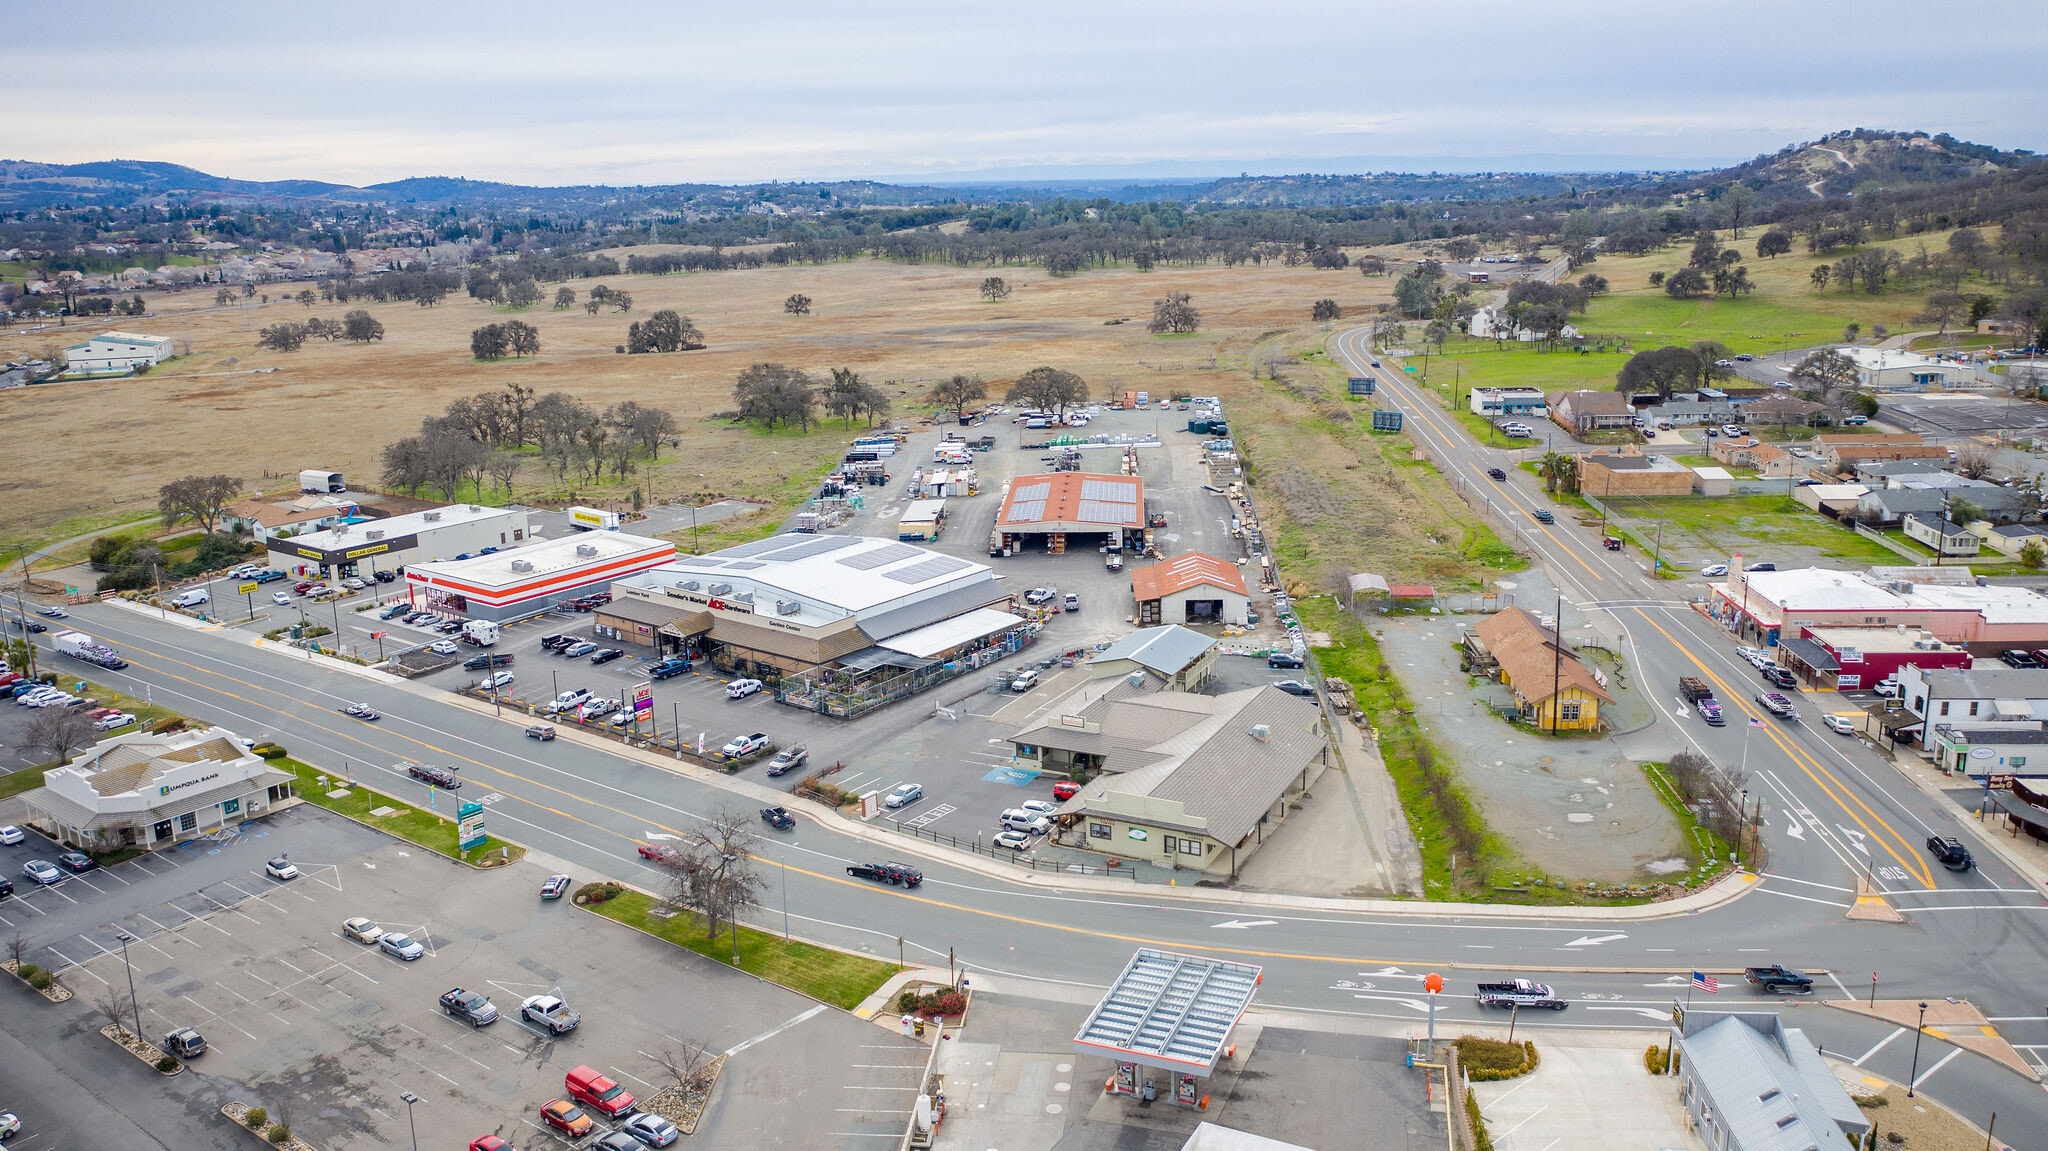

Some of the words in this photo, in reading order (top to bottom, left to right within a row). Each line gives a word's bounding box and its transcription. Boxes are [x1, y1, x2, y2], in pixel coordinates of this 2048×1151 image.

[348, 550, 366, 558] DOLLAR
[366, 546, 386, 554] GENERAL
[406, 572, 428, 582] AutoZone
[667, 591, 688, 601] Sender's
[690, 596, 708, 605] Market
[708, 597, 725, 611] ACE
[725, 604, 750, 614] Hardware
[636, 689, 649, 698] ACE
[170, 779, 199, 791] UMPQUA
[201, 773, 219, 782] BANK
[1878, 866, 1908, 880] STOP
